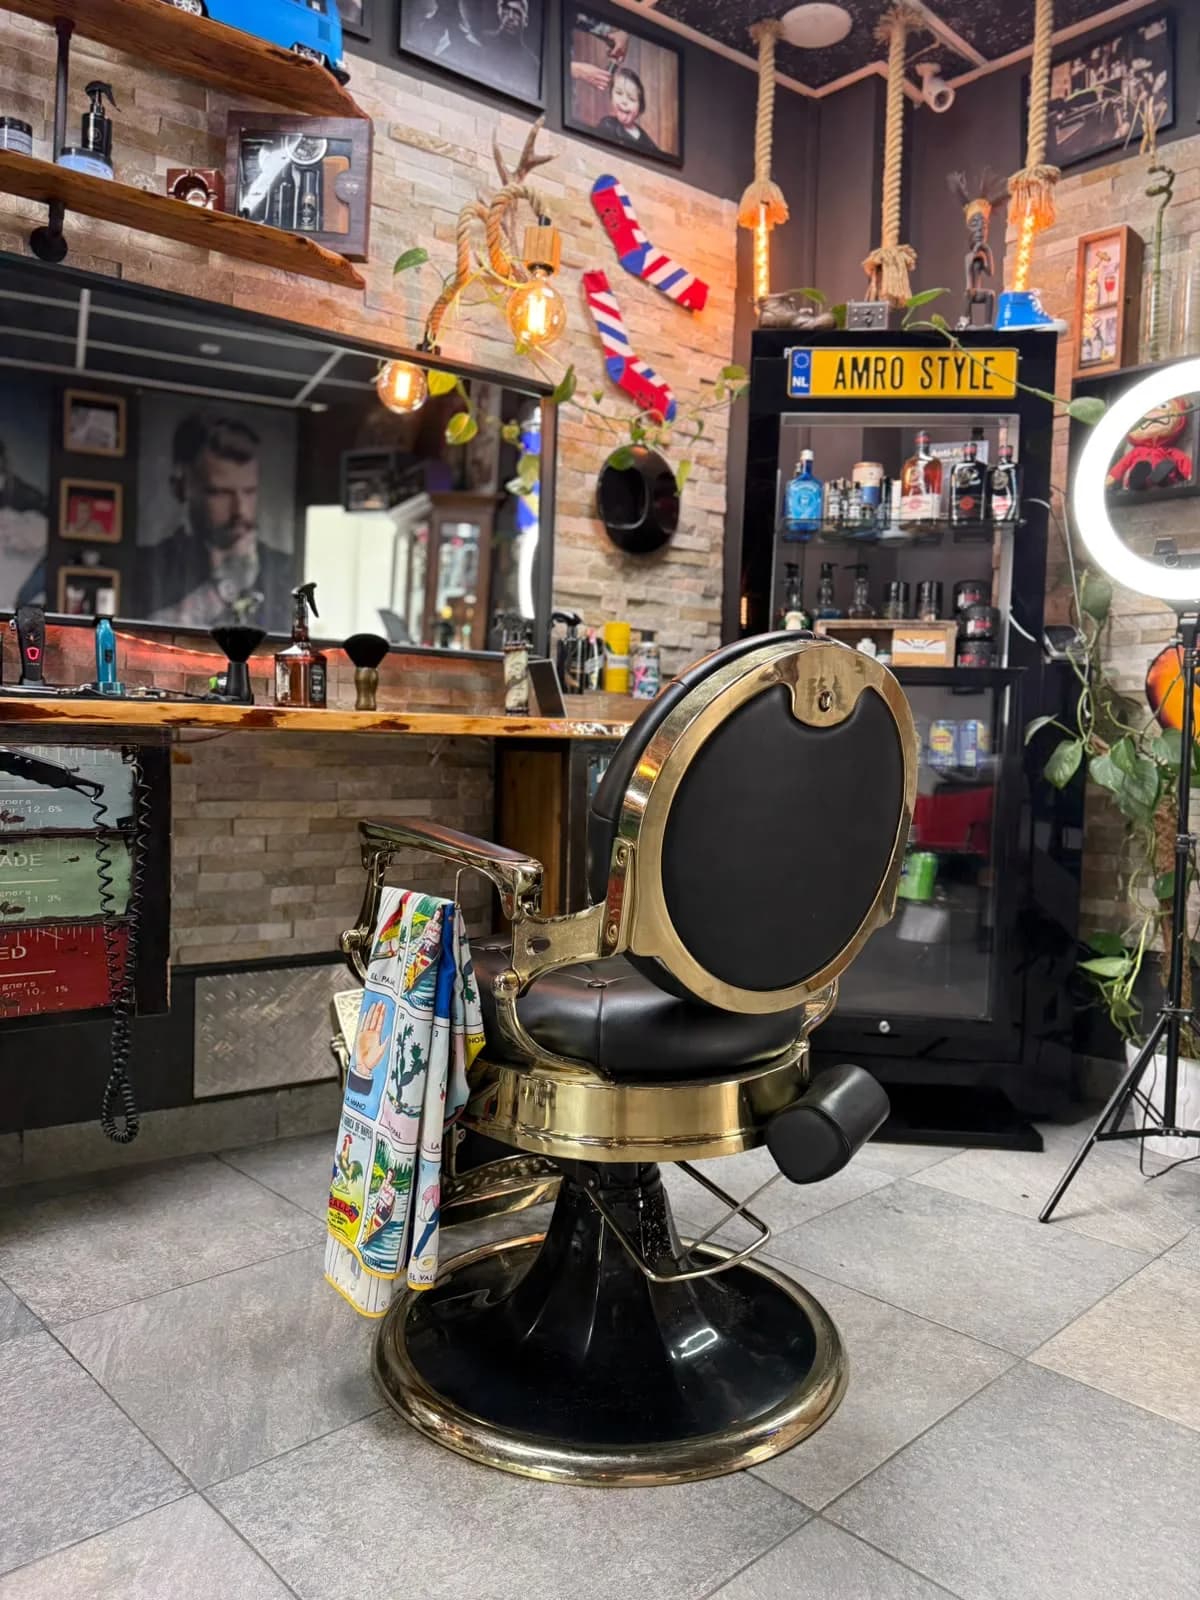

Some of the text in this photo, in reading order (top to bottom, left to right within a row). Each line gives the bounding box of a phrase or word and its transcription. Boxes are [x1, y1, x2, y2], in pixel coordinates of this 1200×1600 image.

[791, 375, 809, 388] NL
[834, 356, 995, 390] AMRO STYLE
